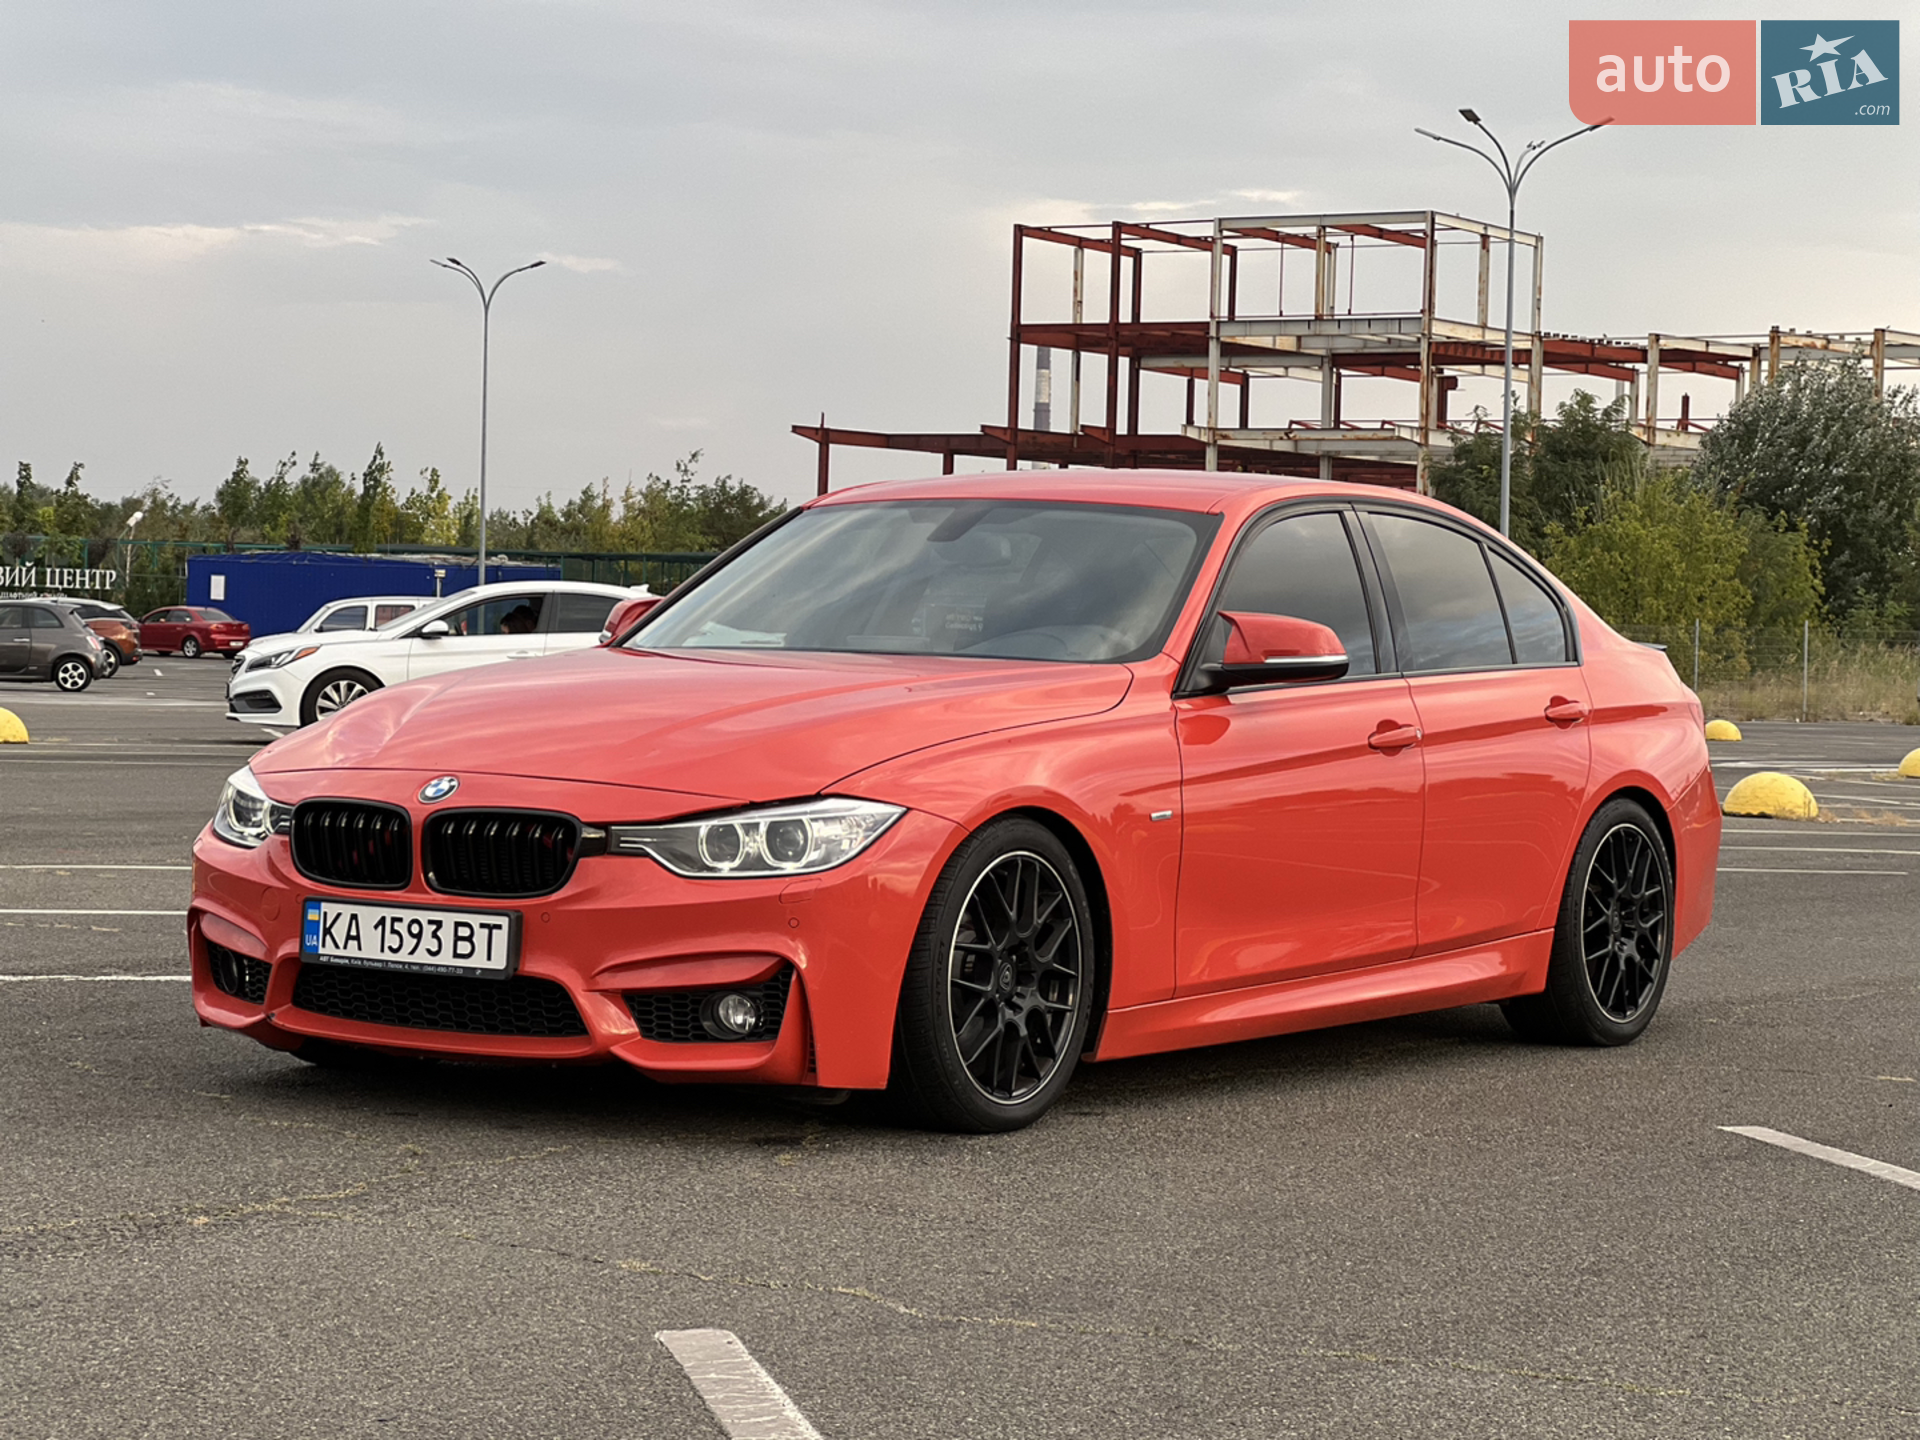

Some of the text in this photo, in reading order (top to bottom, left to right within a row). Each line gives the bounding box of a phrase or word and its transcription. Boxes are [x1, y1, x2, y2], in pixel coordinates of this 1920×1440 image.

[45, 567, 117, 591] ЦЕНТР
[305, 934, 318, 947] UA
[321, 911, 503, 962] KA 1593 BT
